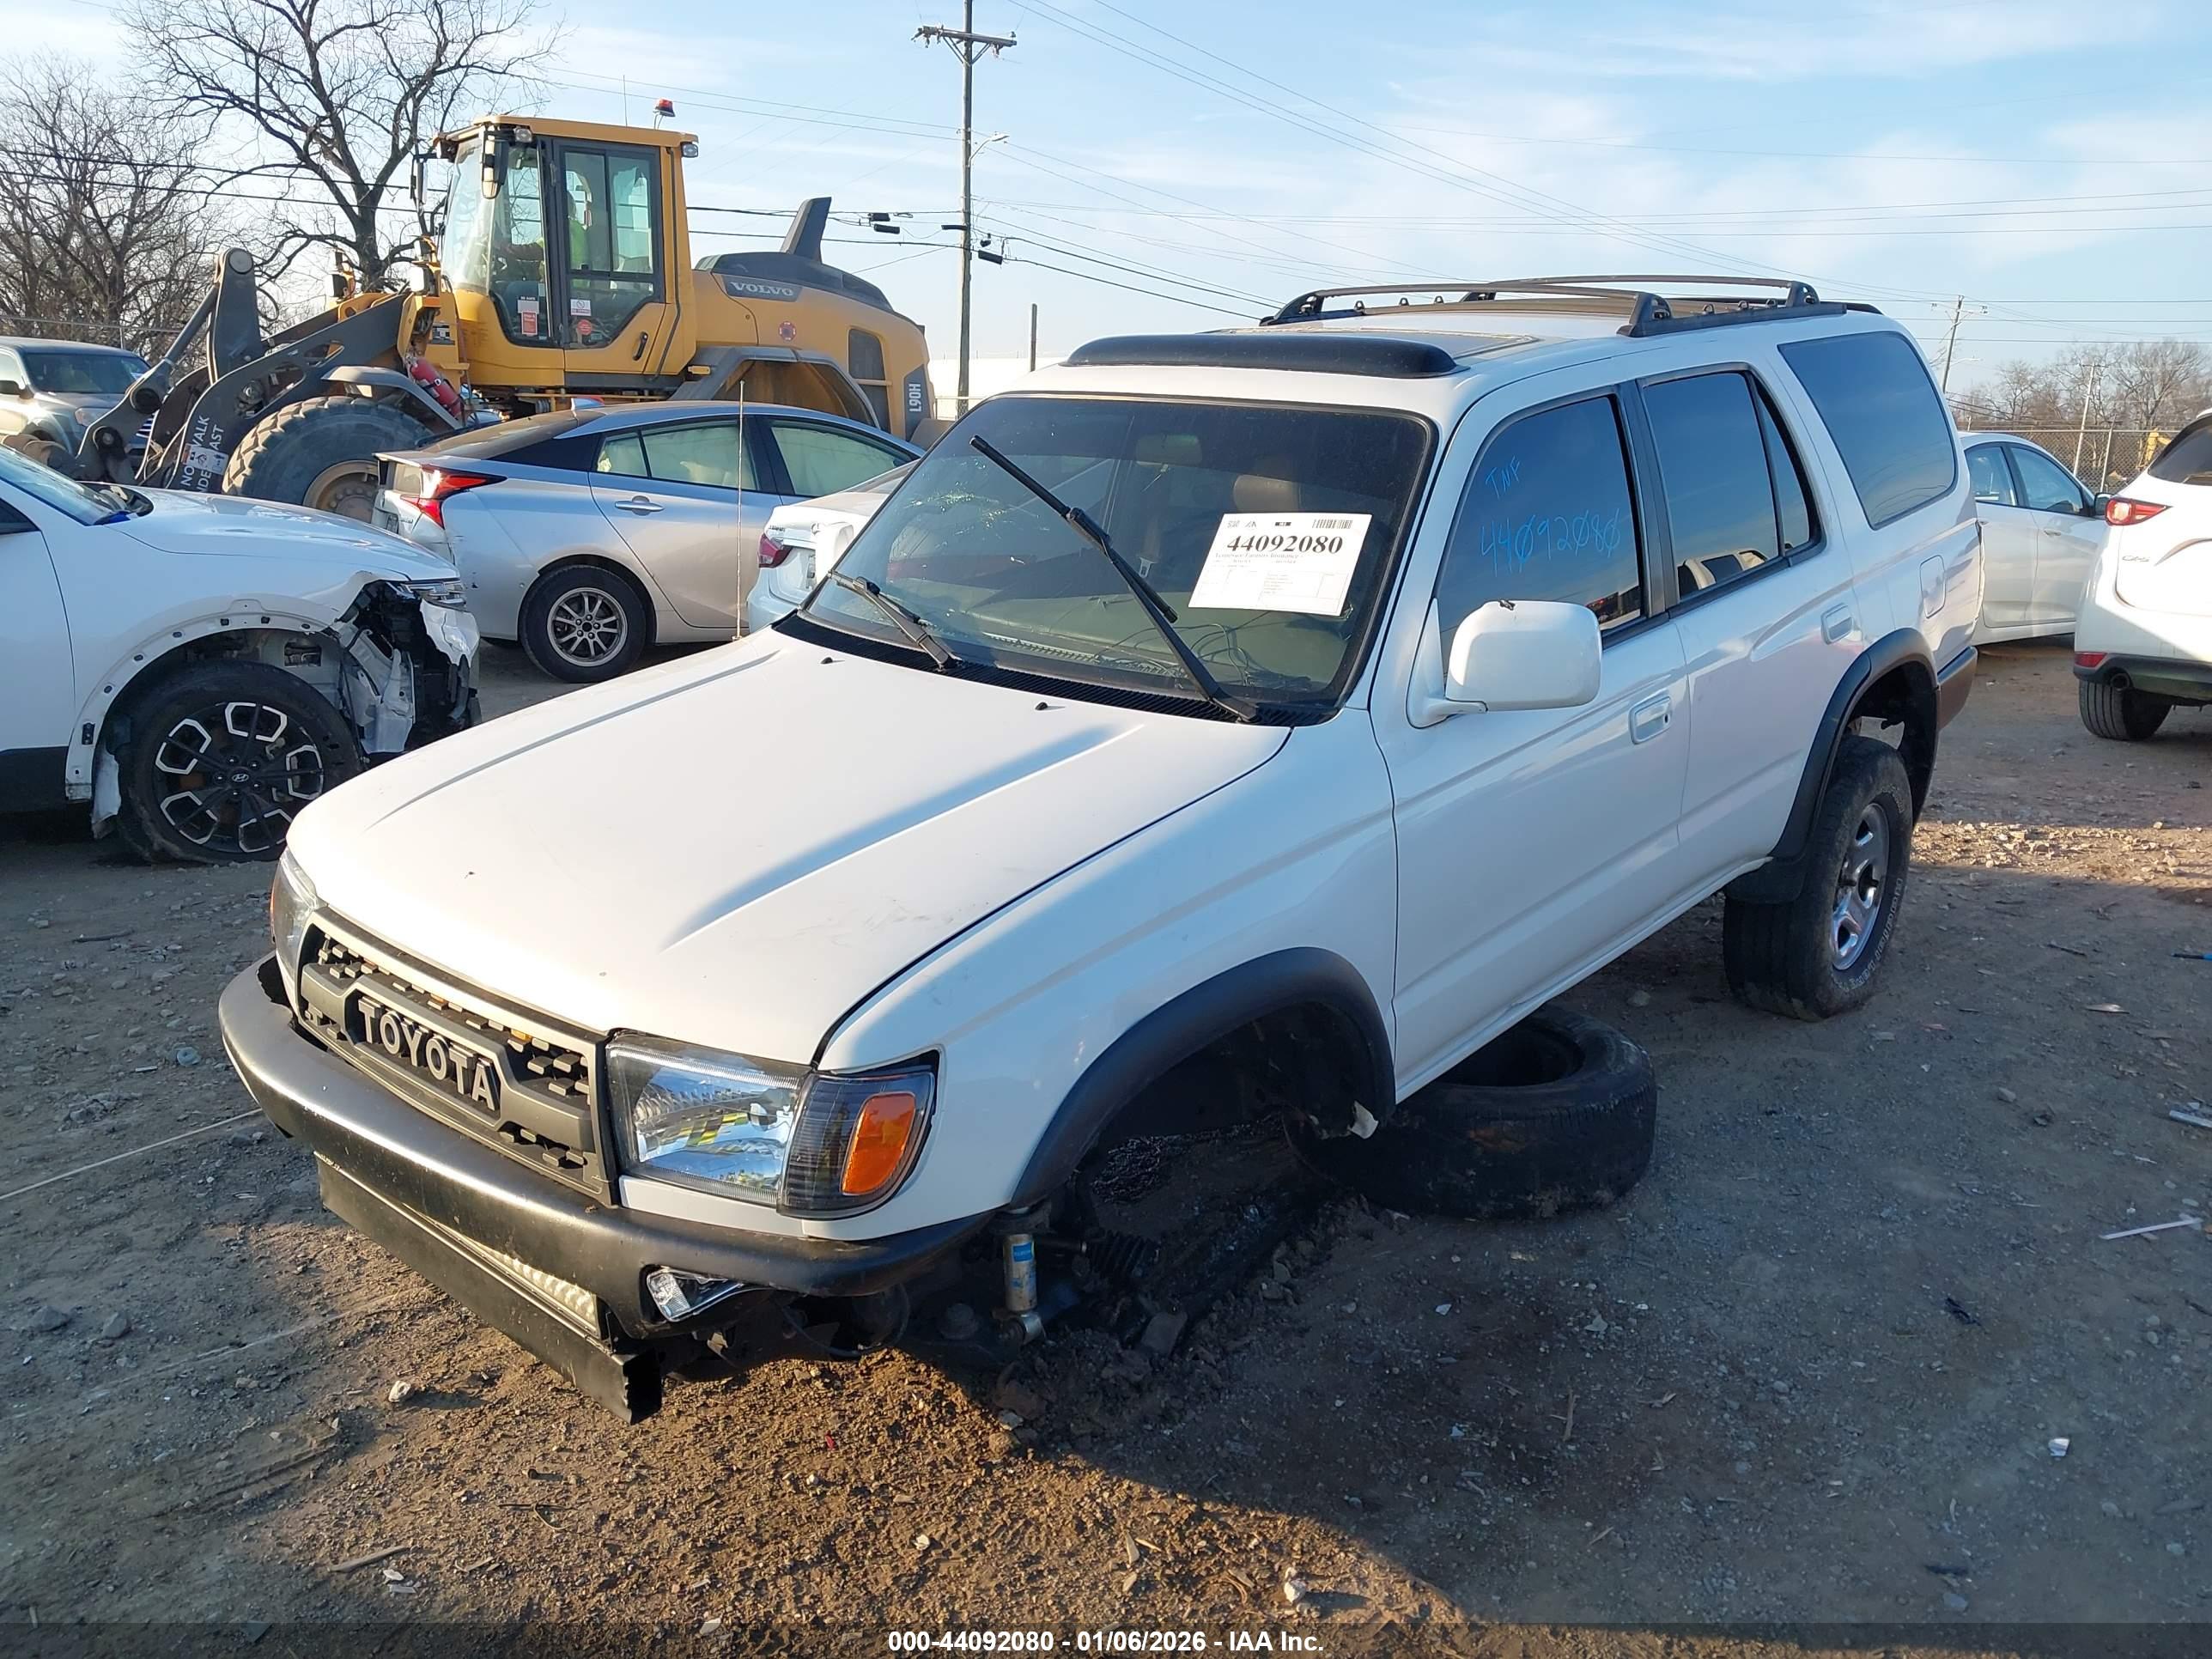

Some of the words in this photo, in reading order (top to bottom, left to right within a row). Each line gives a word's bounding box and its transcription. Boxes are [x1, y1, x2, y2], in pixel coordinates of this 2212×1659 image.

[730, 282, 793, 296] VOLVO
[908, 383, 921, 412] L90H
[209, 424, 225, 451] AST
[179, 465, 195, 487] NO
[1227, 534, 1343, 554] 44092080
[357, 996, 496, 1111] TOYOTA
